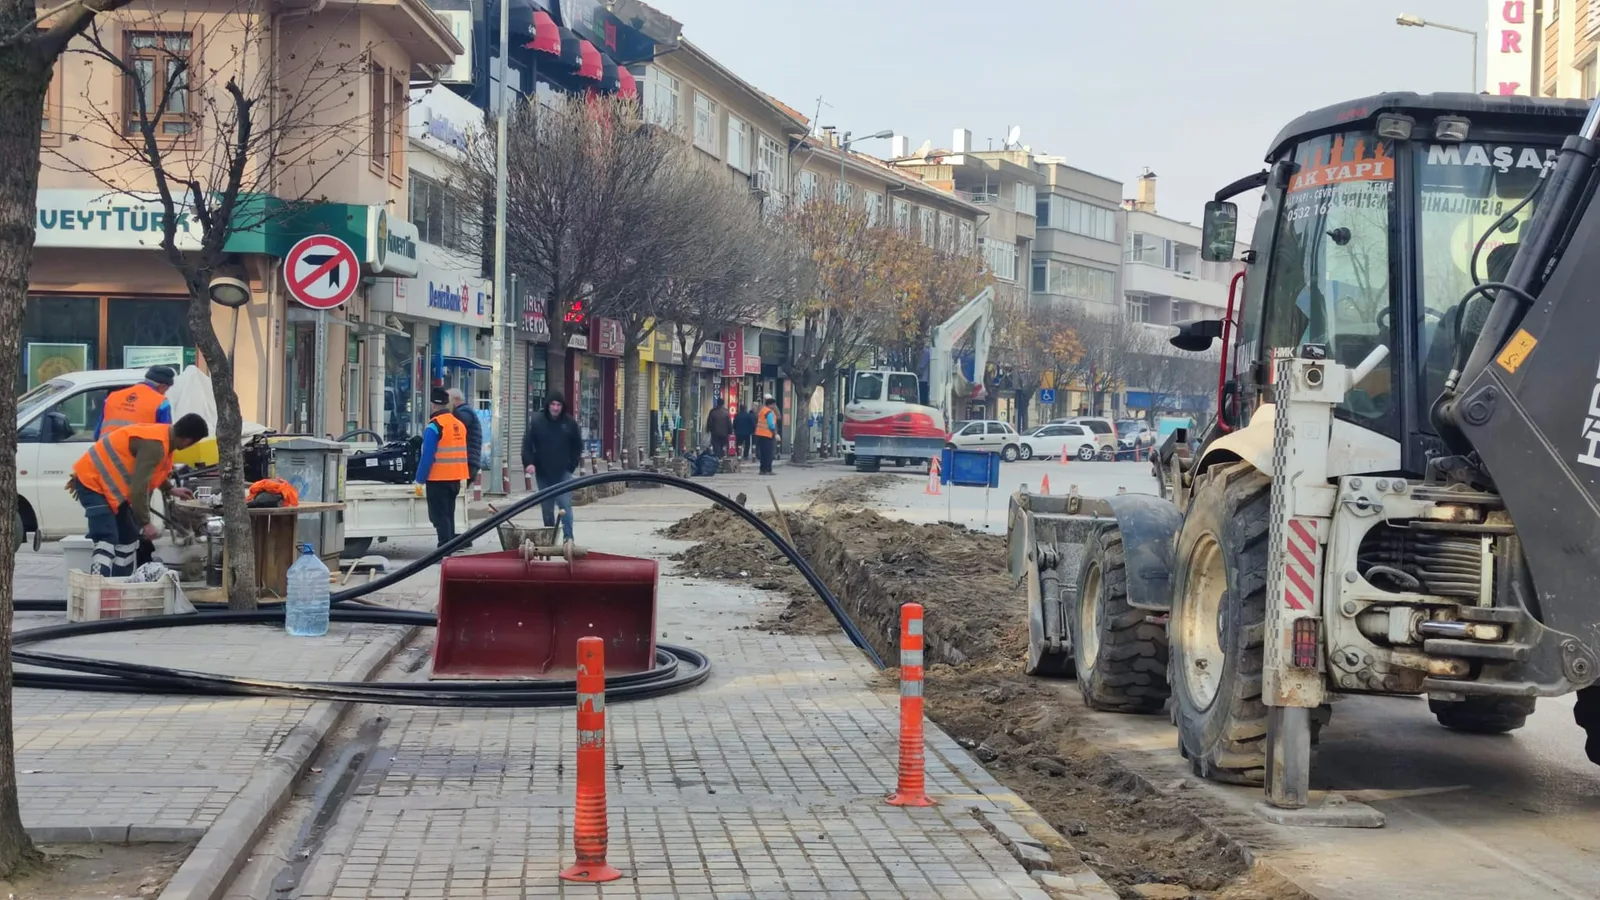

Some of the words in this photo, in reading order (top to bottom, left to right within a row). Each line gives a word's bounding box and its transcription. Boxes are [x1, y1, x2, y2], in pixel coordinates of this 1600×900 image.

[1293, 170, 1319, 189] AK
[1325, 162, 1385, 181] YAPI
[35, 205, 190, 233] VEYTTÜRK
[1287, 205, 1311, 221] 0532
[428, 281, 461, 312] DenizBank
[728, 332, 737, 375] NOTER
[1273, 347, 1295, 358] HMK
